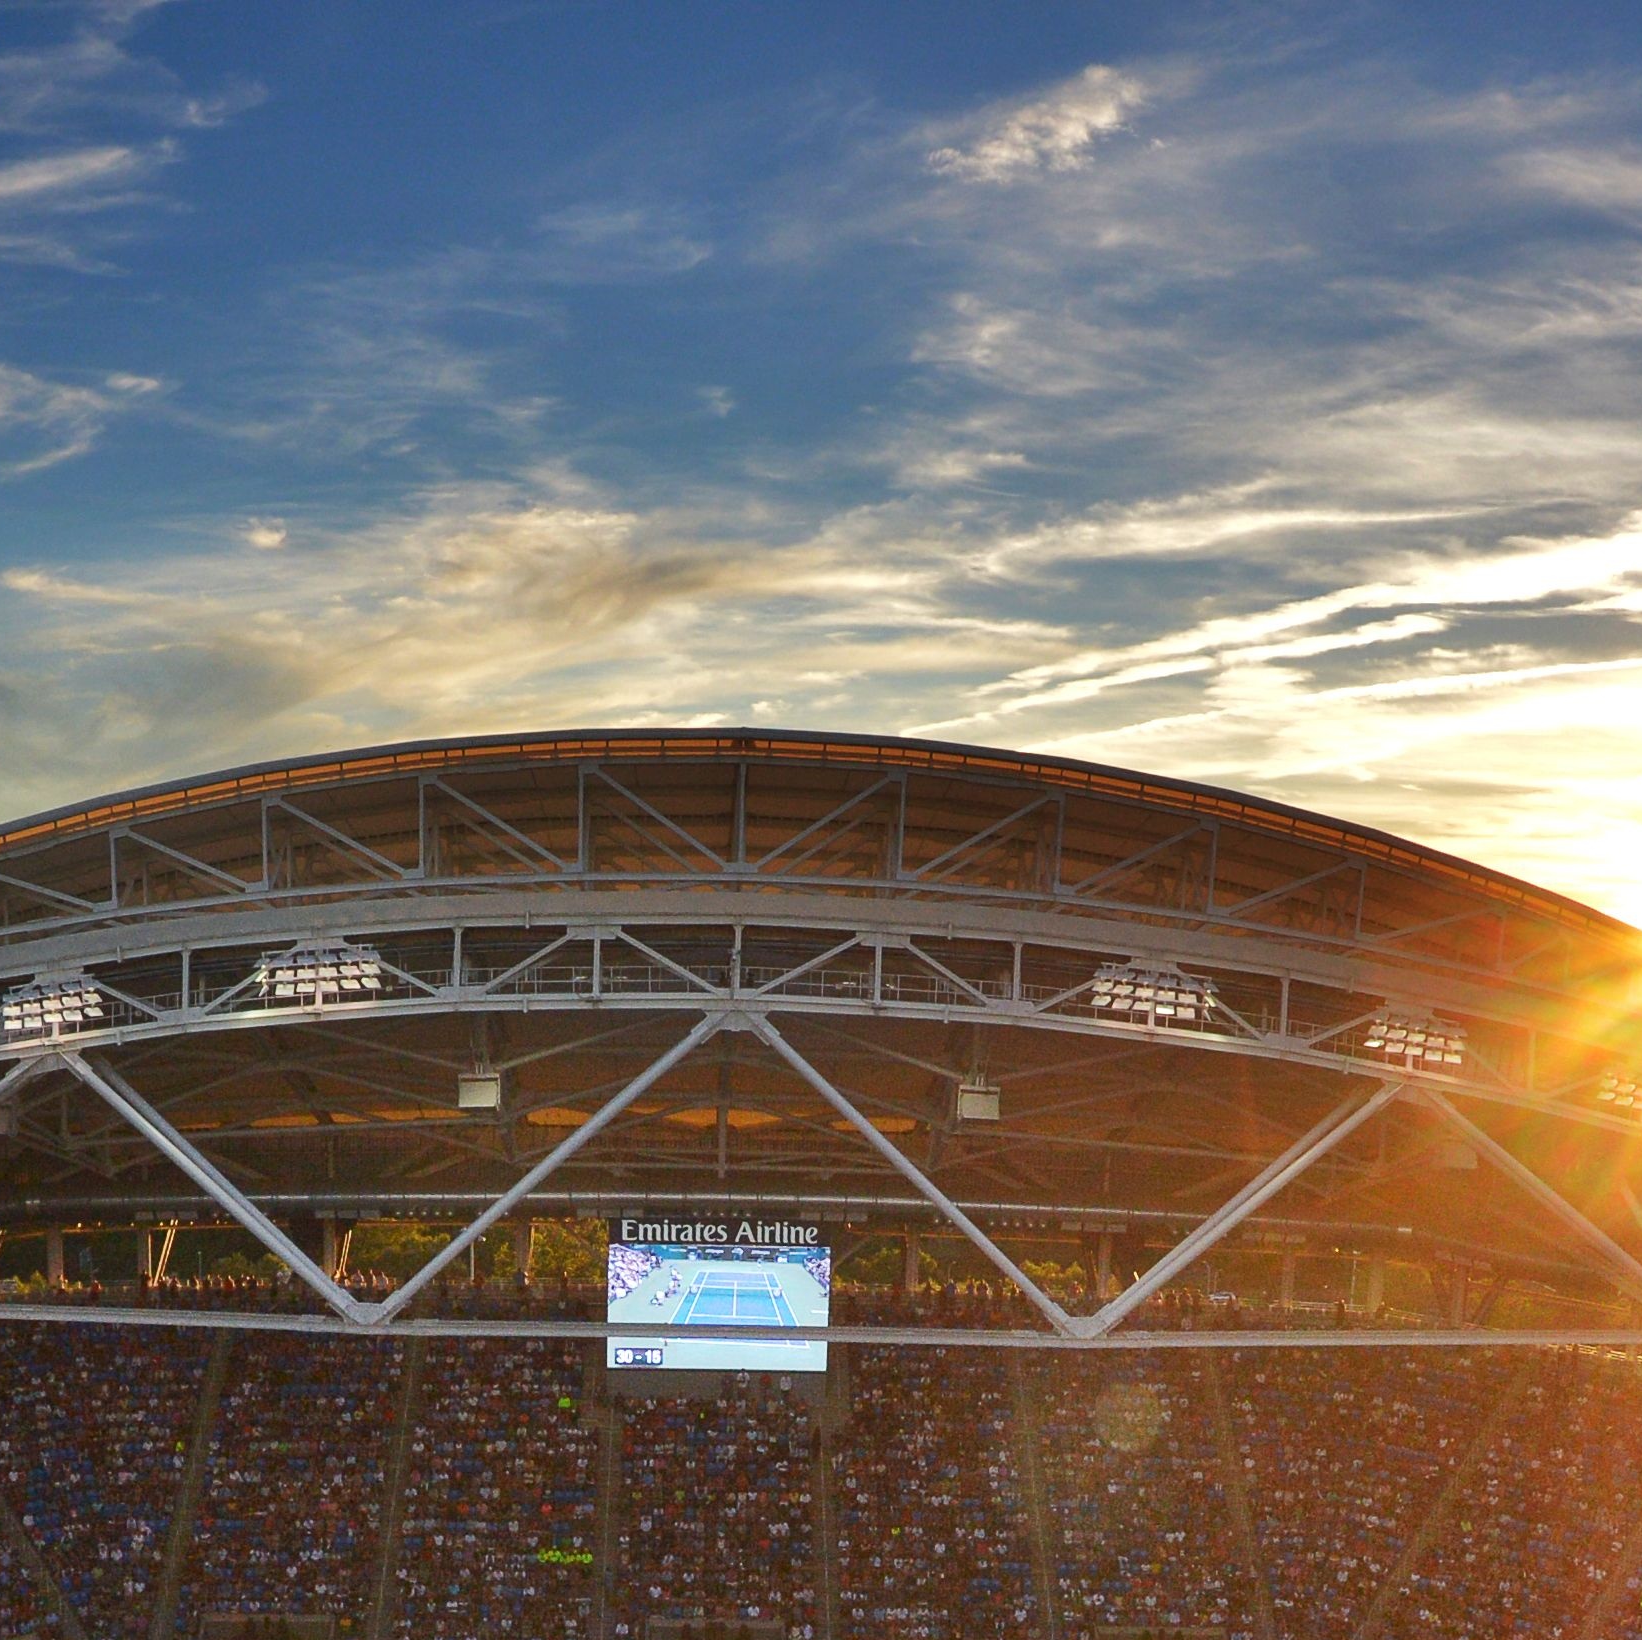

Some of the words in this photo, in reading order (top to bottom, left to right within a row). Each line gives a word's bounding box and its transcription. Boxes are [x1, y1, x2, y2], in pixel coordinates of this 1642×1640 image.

[621, 1219, 728, 1243] Emirates
[735, 1220, 818, 1244] Airline
[616, 1349, 633, 1364] 30
